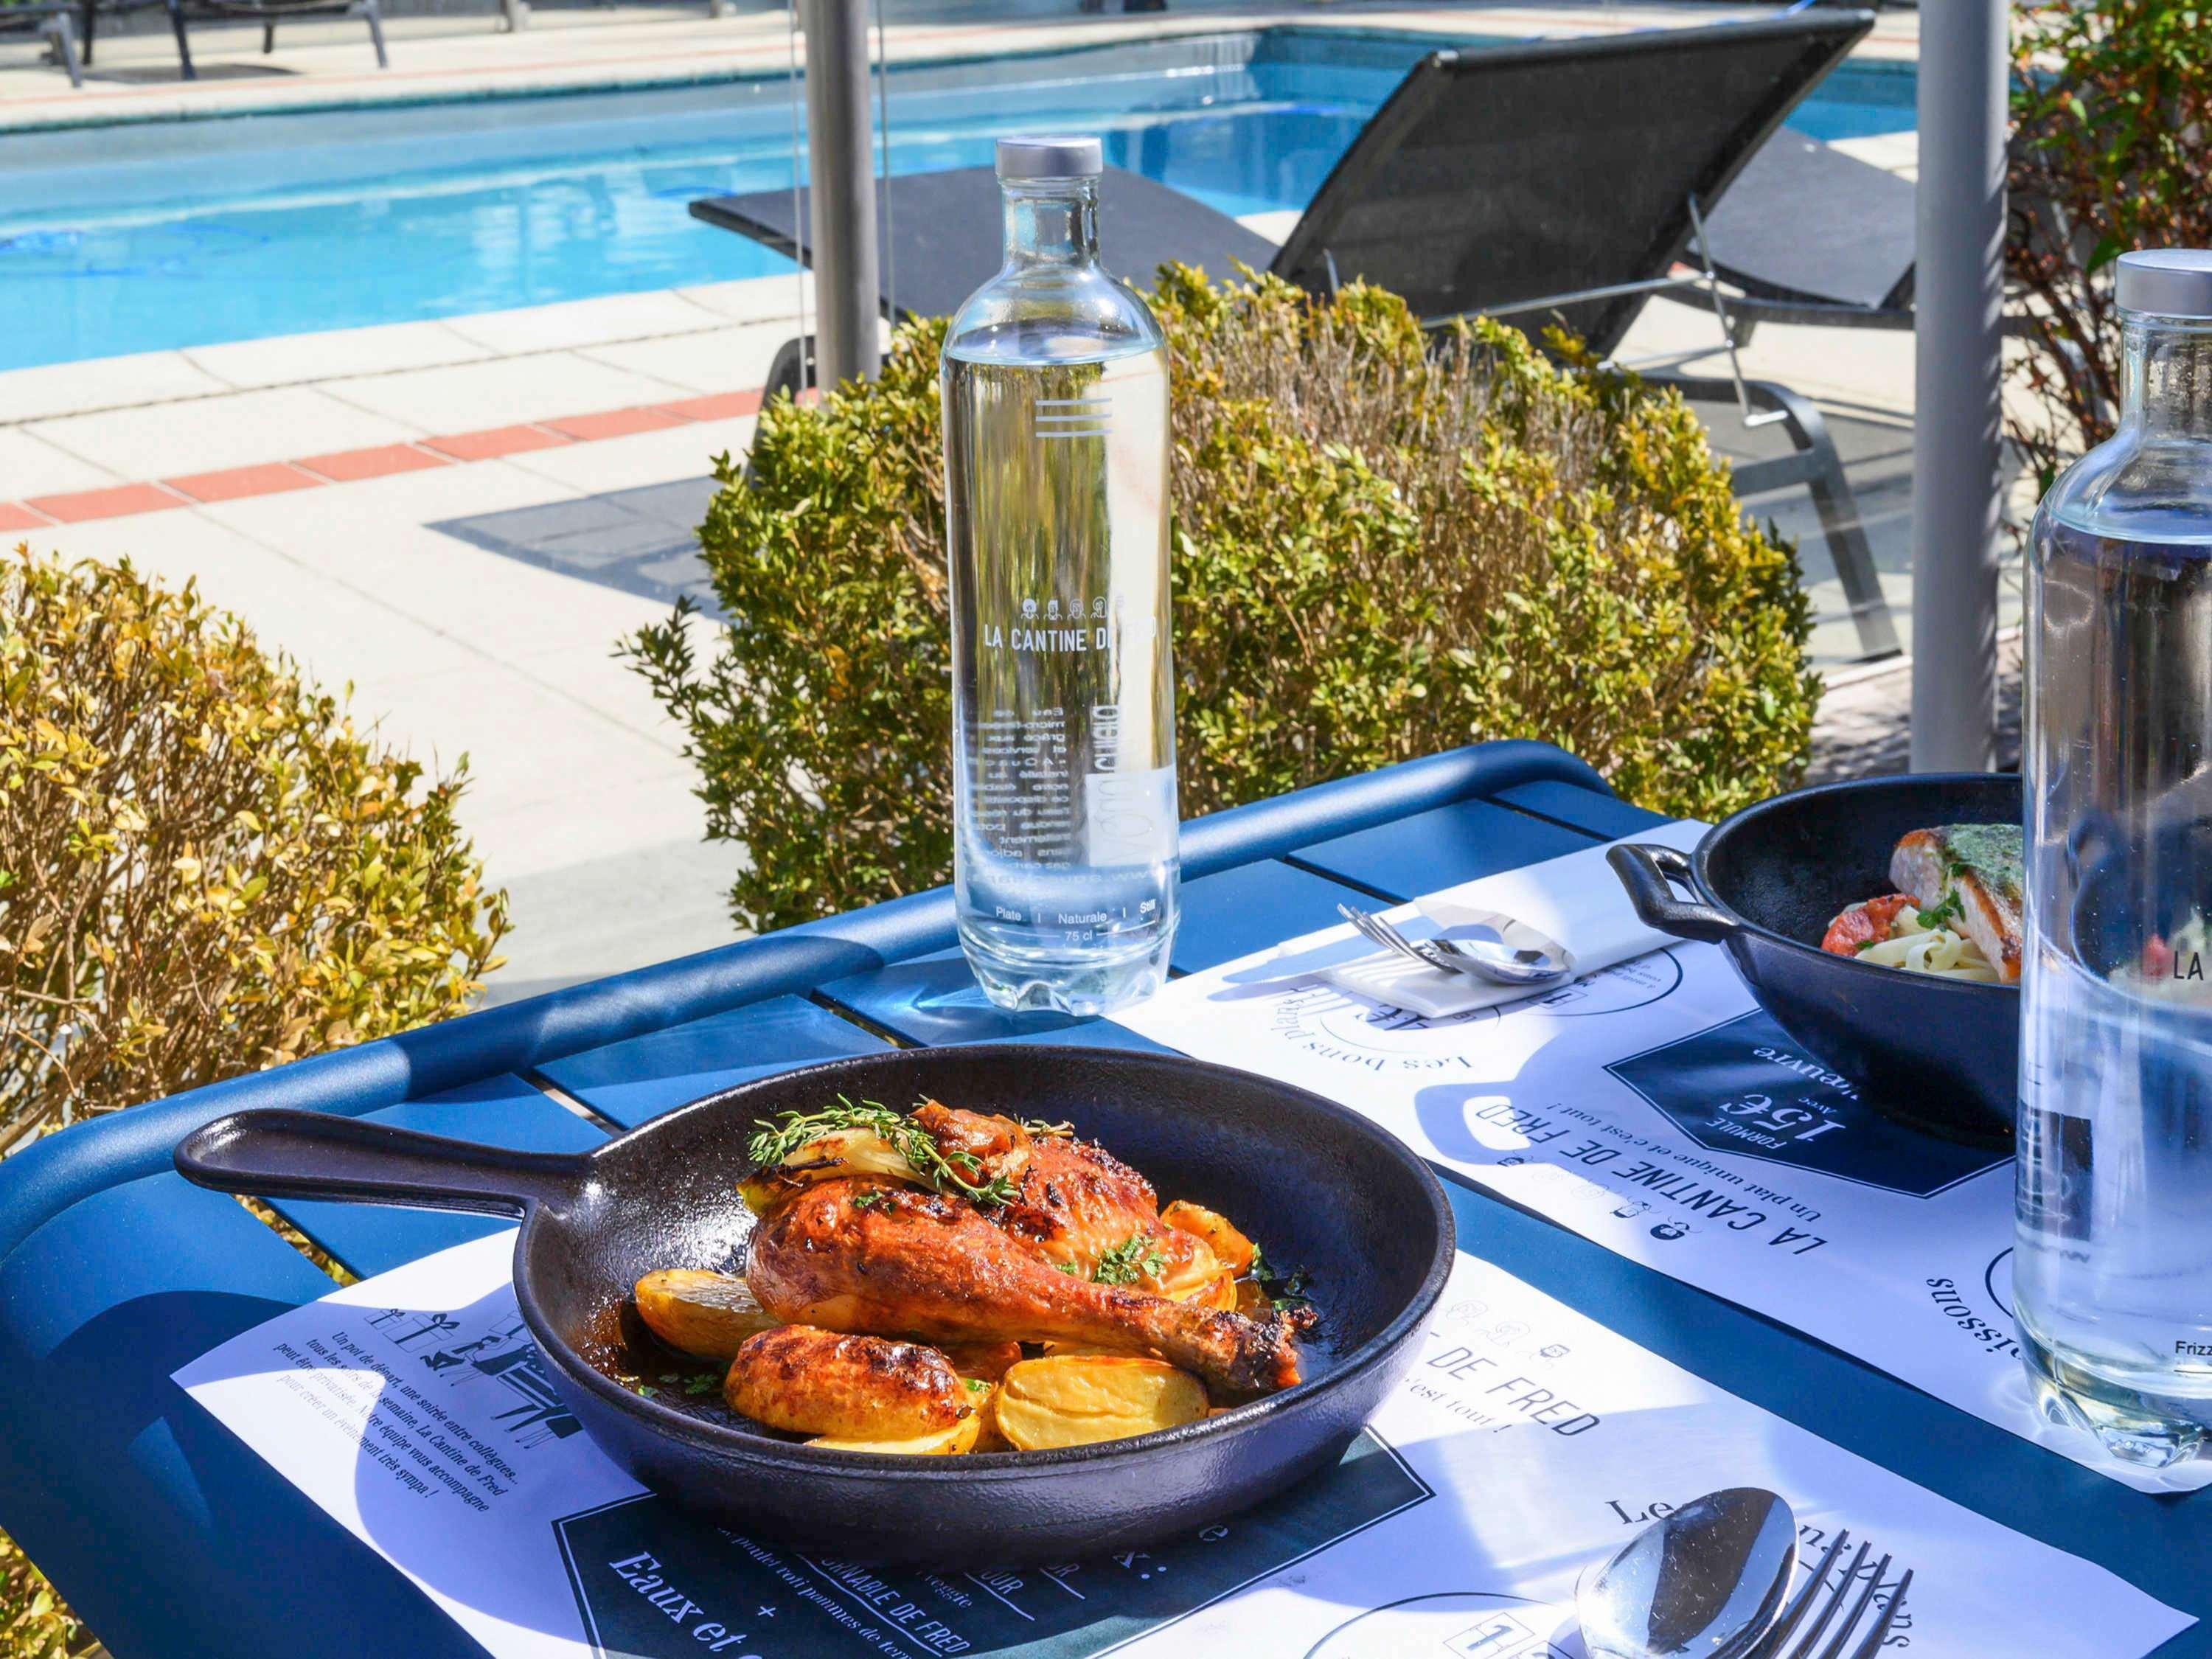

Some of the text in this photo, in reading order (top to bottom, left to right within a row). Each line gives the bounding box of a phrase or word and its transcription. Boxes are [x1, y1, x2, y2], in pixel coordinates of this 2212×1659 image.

[984, 624, 1003, 649] LA
[1011, 628, 1087, 652] CANTINE
[1140, 899, 1156, 914] Still
[1065, 930, 1093, 941] 75 cl
[2174, 950, 2204, 981] LA
[1559, 1108, 1601, 1127] tout
[1719, 1094, 1846, 1142] 15€
[1798, 1096, 1837, 1115] Avec
[1601, 1126, 1649, 1146] c'est
[1647, 1144, 1672, 1155] et
[1705, 1117, 1787, 1150] FORMULE
[1476, 1105, 1827, 1255] LA CANTINE DE FRED
[1674, 1153, 1744, 1185] unique
[1744, 1183, 1792, 1205] plat
[1790, 1202, 1821, 1222] Un
[1926, 1279, 2021, 1360] issons
[332, 1332, 348, 1346] Un
[341, 1342, 363, 1357] pot
[359, 1354, 374, 1365] de
[400, 1385, 421, 1401] une
[417, 1399, 448, 1422] soirée
[444, 1420, 473, 1440] entre
[1427, 1346, 1600, 1436] DE FRED
[273, 1343, 302, 1361] peut
[295, 1357, 316, 1372] être
[359, 1405, 383, 1427] Notre
[379, 1425, 412, 1450] équipe
[408, 1447, 433, 1467] vous
[428, 1464, 490, 1512] accompagne
[306, 1338, 329, 1357] tous
[324, 1352, 341, 1366] les
[378, 1396, 418, 1429] semaine,
[416, 1425, 432, 1439] La
[428, 1435, 468, 1467] Cantine
[465, 1464, 481, 1477] de
[477, 1474, 509, 1496] Fred
[1446, 1400, 1497, 1425] tout
[276, 1374, 304, 1392] pour
[322, 1408, 338, 1422] un
[378, 1453, 400, 1472] très
[396, 1469, 429, 1495] sympa
[608, 1551, 747, 1652] Eaux et
[797, 1587, 862, 1630] pommes
[858, 1627, 881, 1642] de
[888, 1602, 927, 1624] DE
[915, 1621, 971, 1653] FRED
